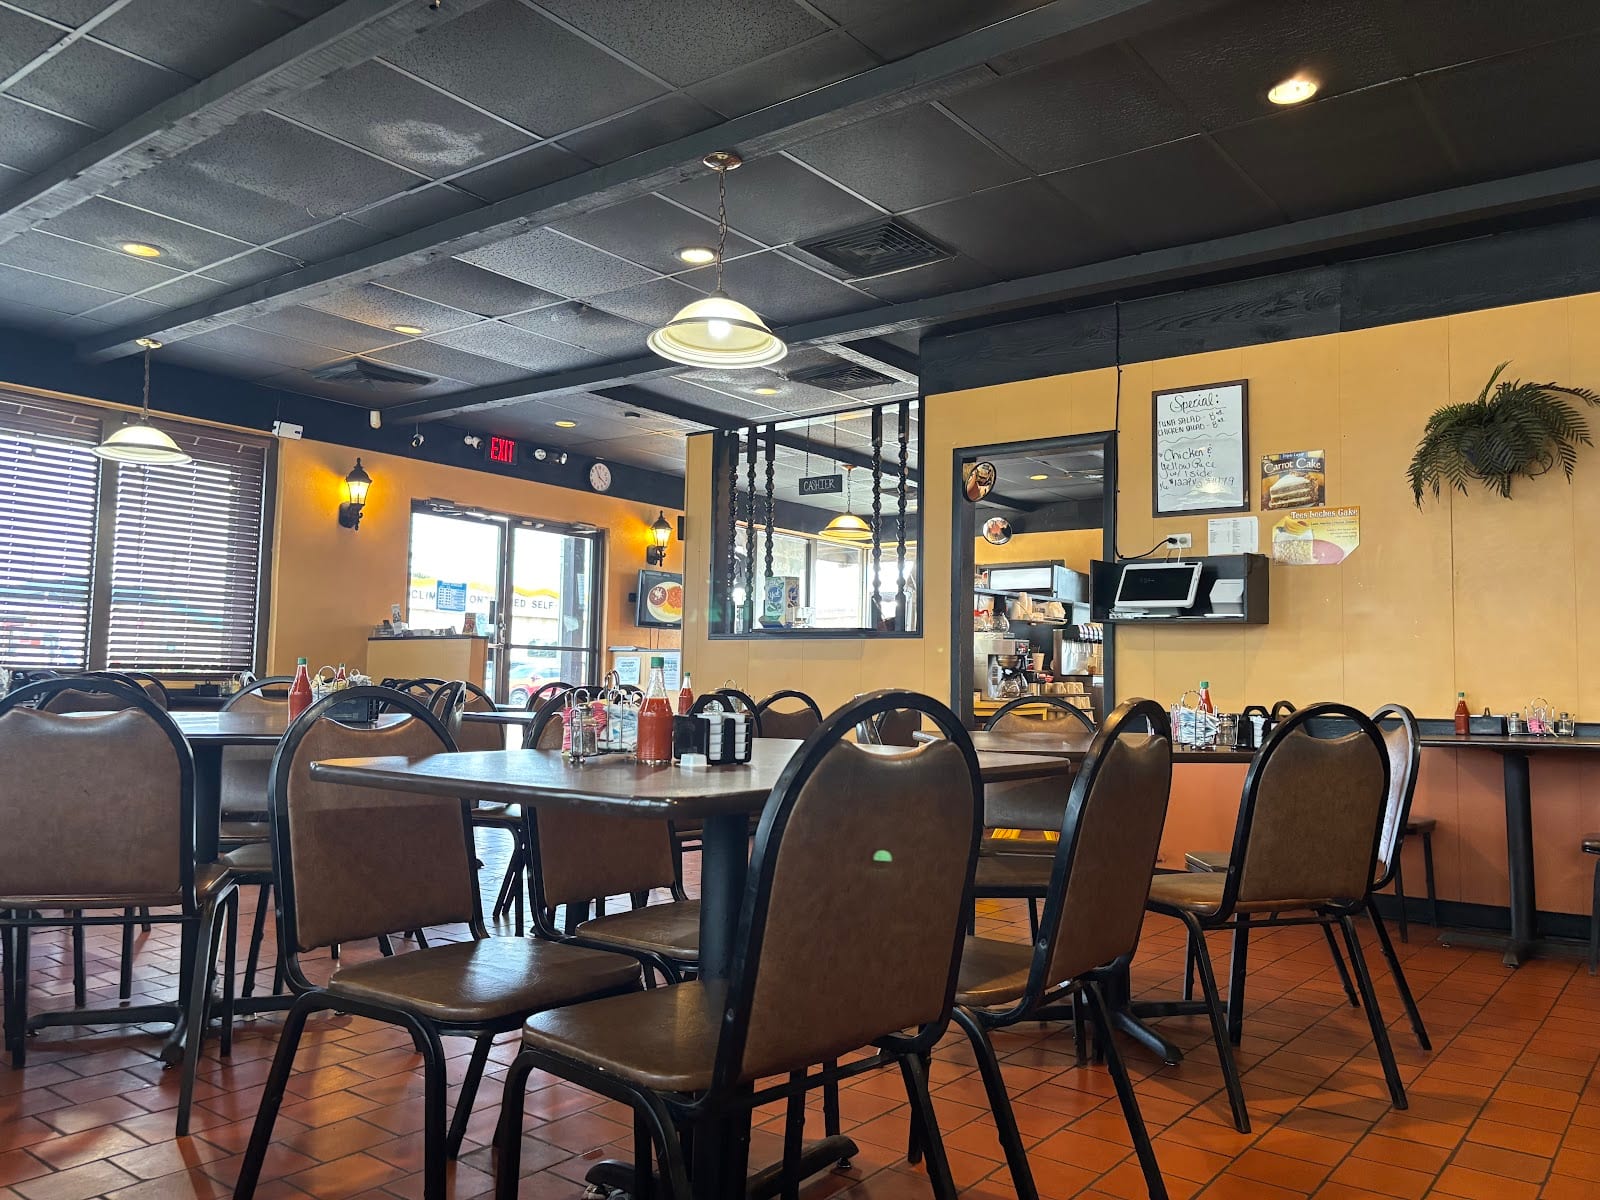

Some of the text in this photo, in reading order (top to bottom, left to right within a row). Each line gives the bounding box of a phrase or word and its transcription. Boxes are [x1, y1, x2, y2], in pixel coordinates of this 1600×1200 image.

[1169, 392, 1219, 414] Special:
[1158, 418, 1176, 428] TUNA
[1178, 415, 1201, 425] SALAD
[490, 437, 515, 463] EXIT
[1163, 447, 1204, 462] Chicken
[1189, 467, 1213, 478] side
[1264, 457, 1321, 474] Carrot Cake
[803, 478, 836, 492] CASHIER
[411, 589, 436, 601] CLIM
